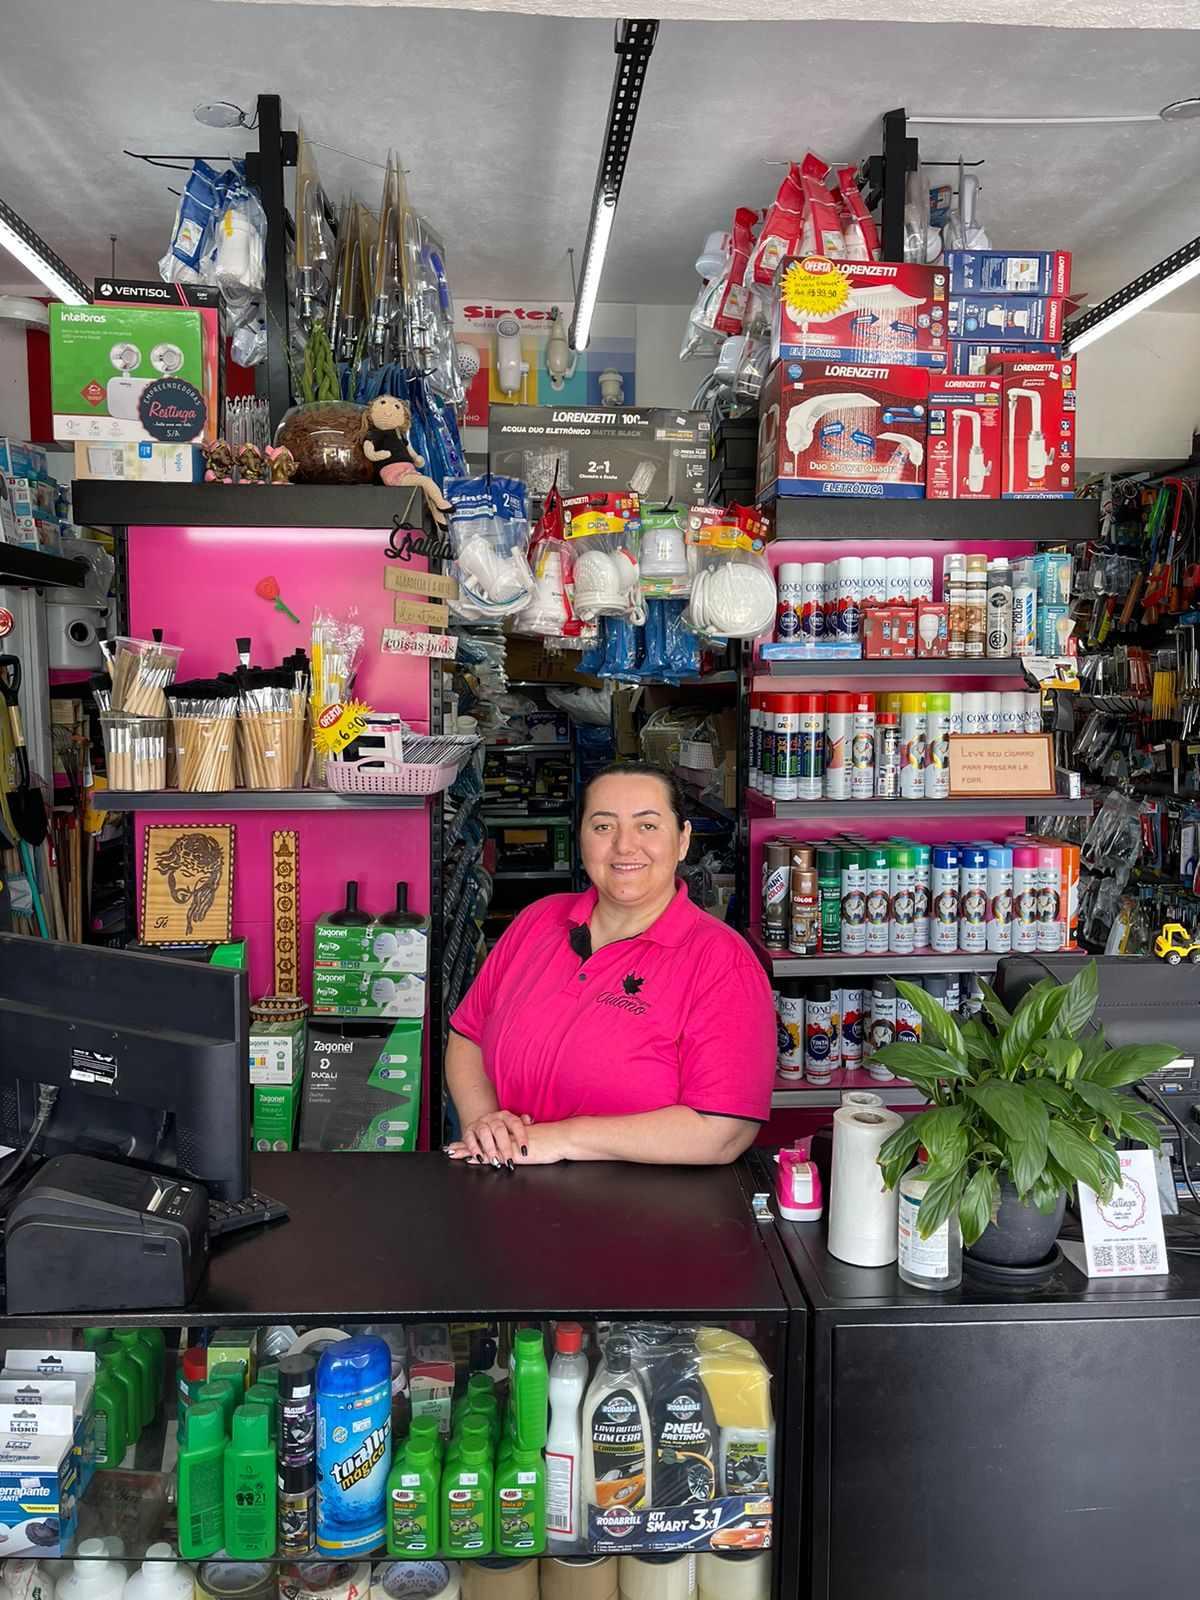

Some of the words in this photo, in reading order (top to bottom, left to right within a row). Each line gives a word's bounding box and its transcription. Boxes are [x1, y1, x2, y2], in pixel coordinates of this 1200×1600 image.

[835, 264, 897, 276] LORENZETTI
[114, 286, 170, 298] VENTISOL
[825, 365, 889, 379] LORENZETTI
[1013, 364, 1055, 372] LORENZETTI
[944, 380, 987, 388] LORENZETTI
[148, 401, 197, 423] Restinga
[552, 411, 616, 424] LORENZETTI
[501, 425, 527, 434] ACQUA
[528, 426, 545, 434] DUO
[545, 426, 591, 436] ELETRÔNICO
[617, 429, 642, 438] BLACK
[809, 460, 828, 471] Duo
[822, 482, 884, 494] ELETRÔNICA
[386, 635, 424, 651] coisas
[320, 705, 344, 727] OFERTA
[318, 927, 348, 937] Zagonel
[316, 973, 346, 983] Zagonel
[250, 1039, 270, 1049] agonel
[313, 1040, 353, 1055] Zagonel
[311, 1071, 338, 1079] DUCALI
[259, 1094, 285, 1104] Zagonel
[602, 1403, 637, 1413] RODABRILL
[667, 1403, 701, 1412] RODABRILL
[594, 1424, 617, 1433] LAVA
[617, 1424, 643, 1432] AUTOS
[664, 1422, 703, 1434] PNEU
[593, 1433, 615, 1442] COM
[615, 1433, 641, 1442] CERA
[661, 1431, 706, 1440] PRETINHO
[596, 1516, 641, 1526] RODABRILL
[646, 1520, 690, 1533] SMART
[689, 1507, 724, 1530] 3x1
[648, 1511, 666, 1521] KIT
